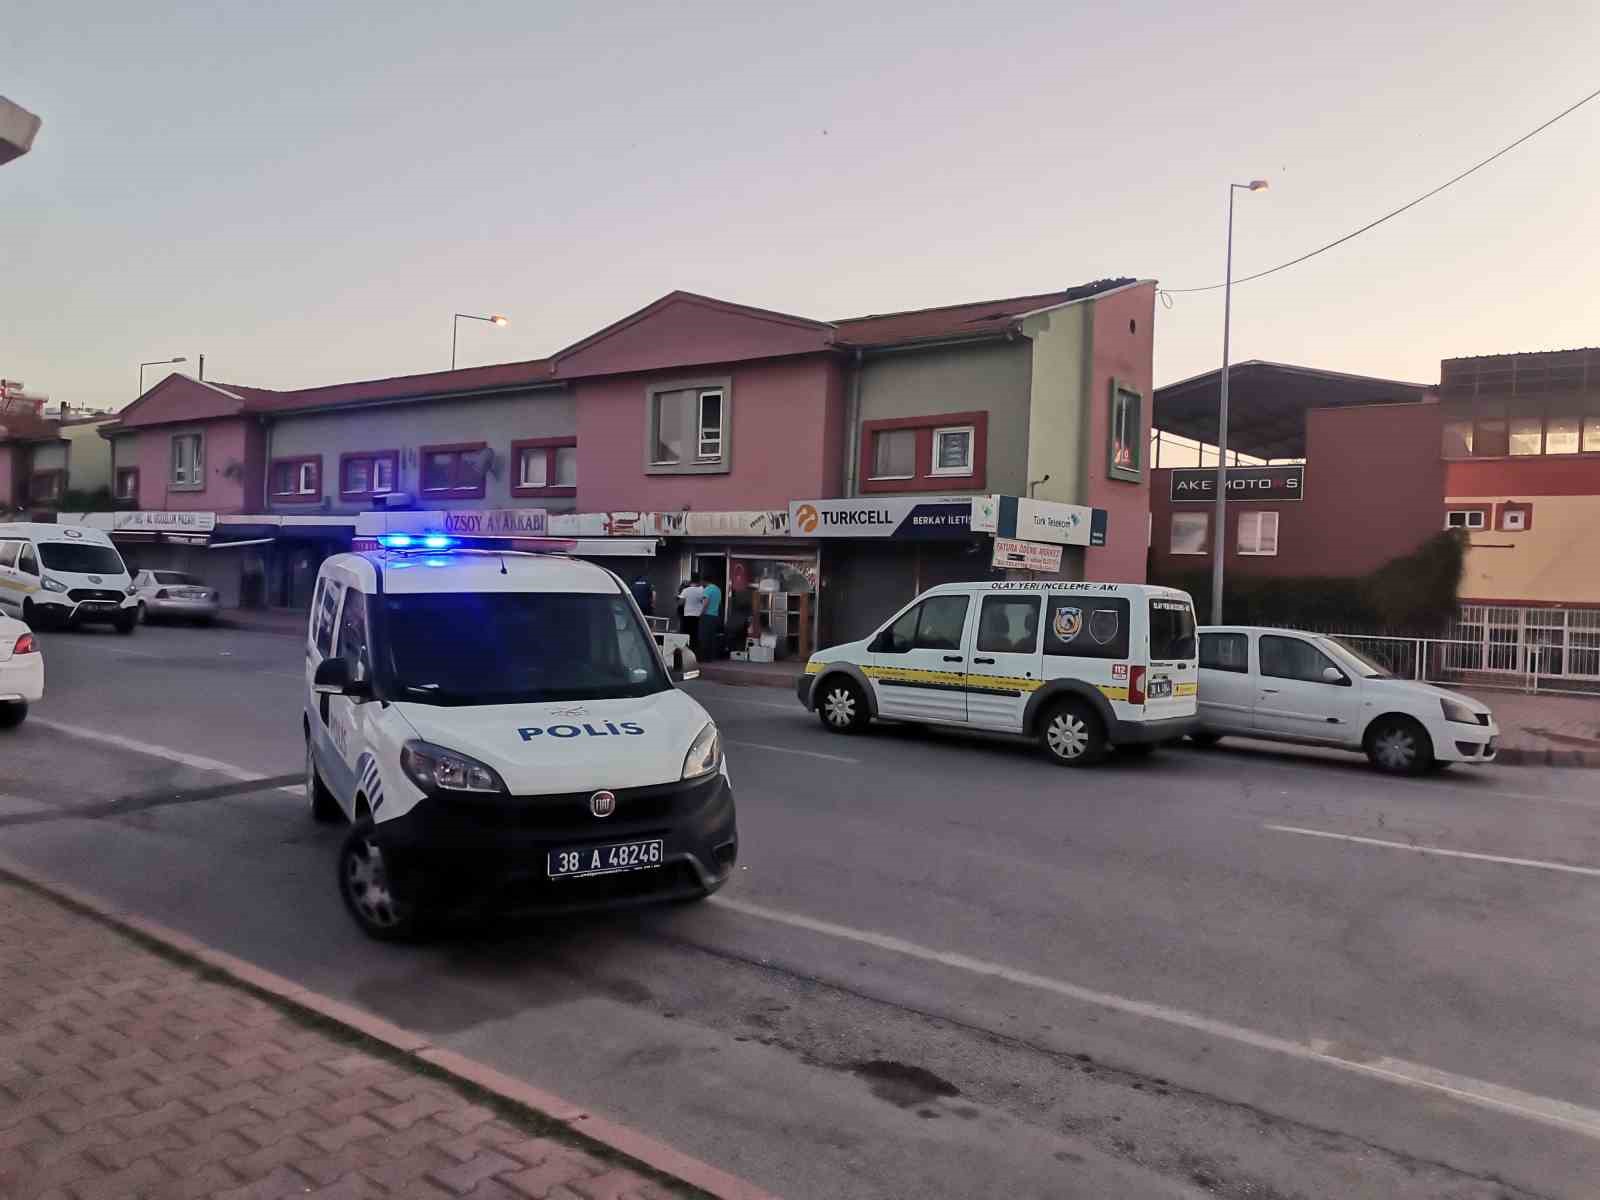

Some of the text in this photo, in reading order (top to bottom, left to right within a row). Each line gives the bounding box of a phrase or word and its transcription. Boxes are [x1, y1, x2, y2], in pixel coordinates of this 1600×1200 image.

[1177, 480, 1212, 490] AKE
[821, 510, 894, 525] TURKCELL
[913, 514, 947, 525] BERKAY
[991, 582, 1017, 590] OLAY
[1114, 664, 1127, 675] 112
[517, 719, 645, 742] POLİS
[559, 843, 660, 873] 38 A 48246
